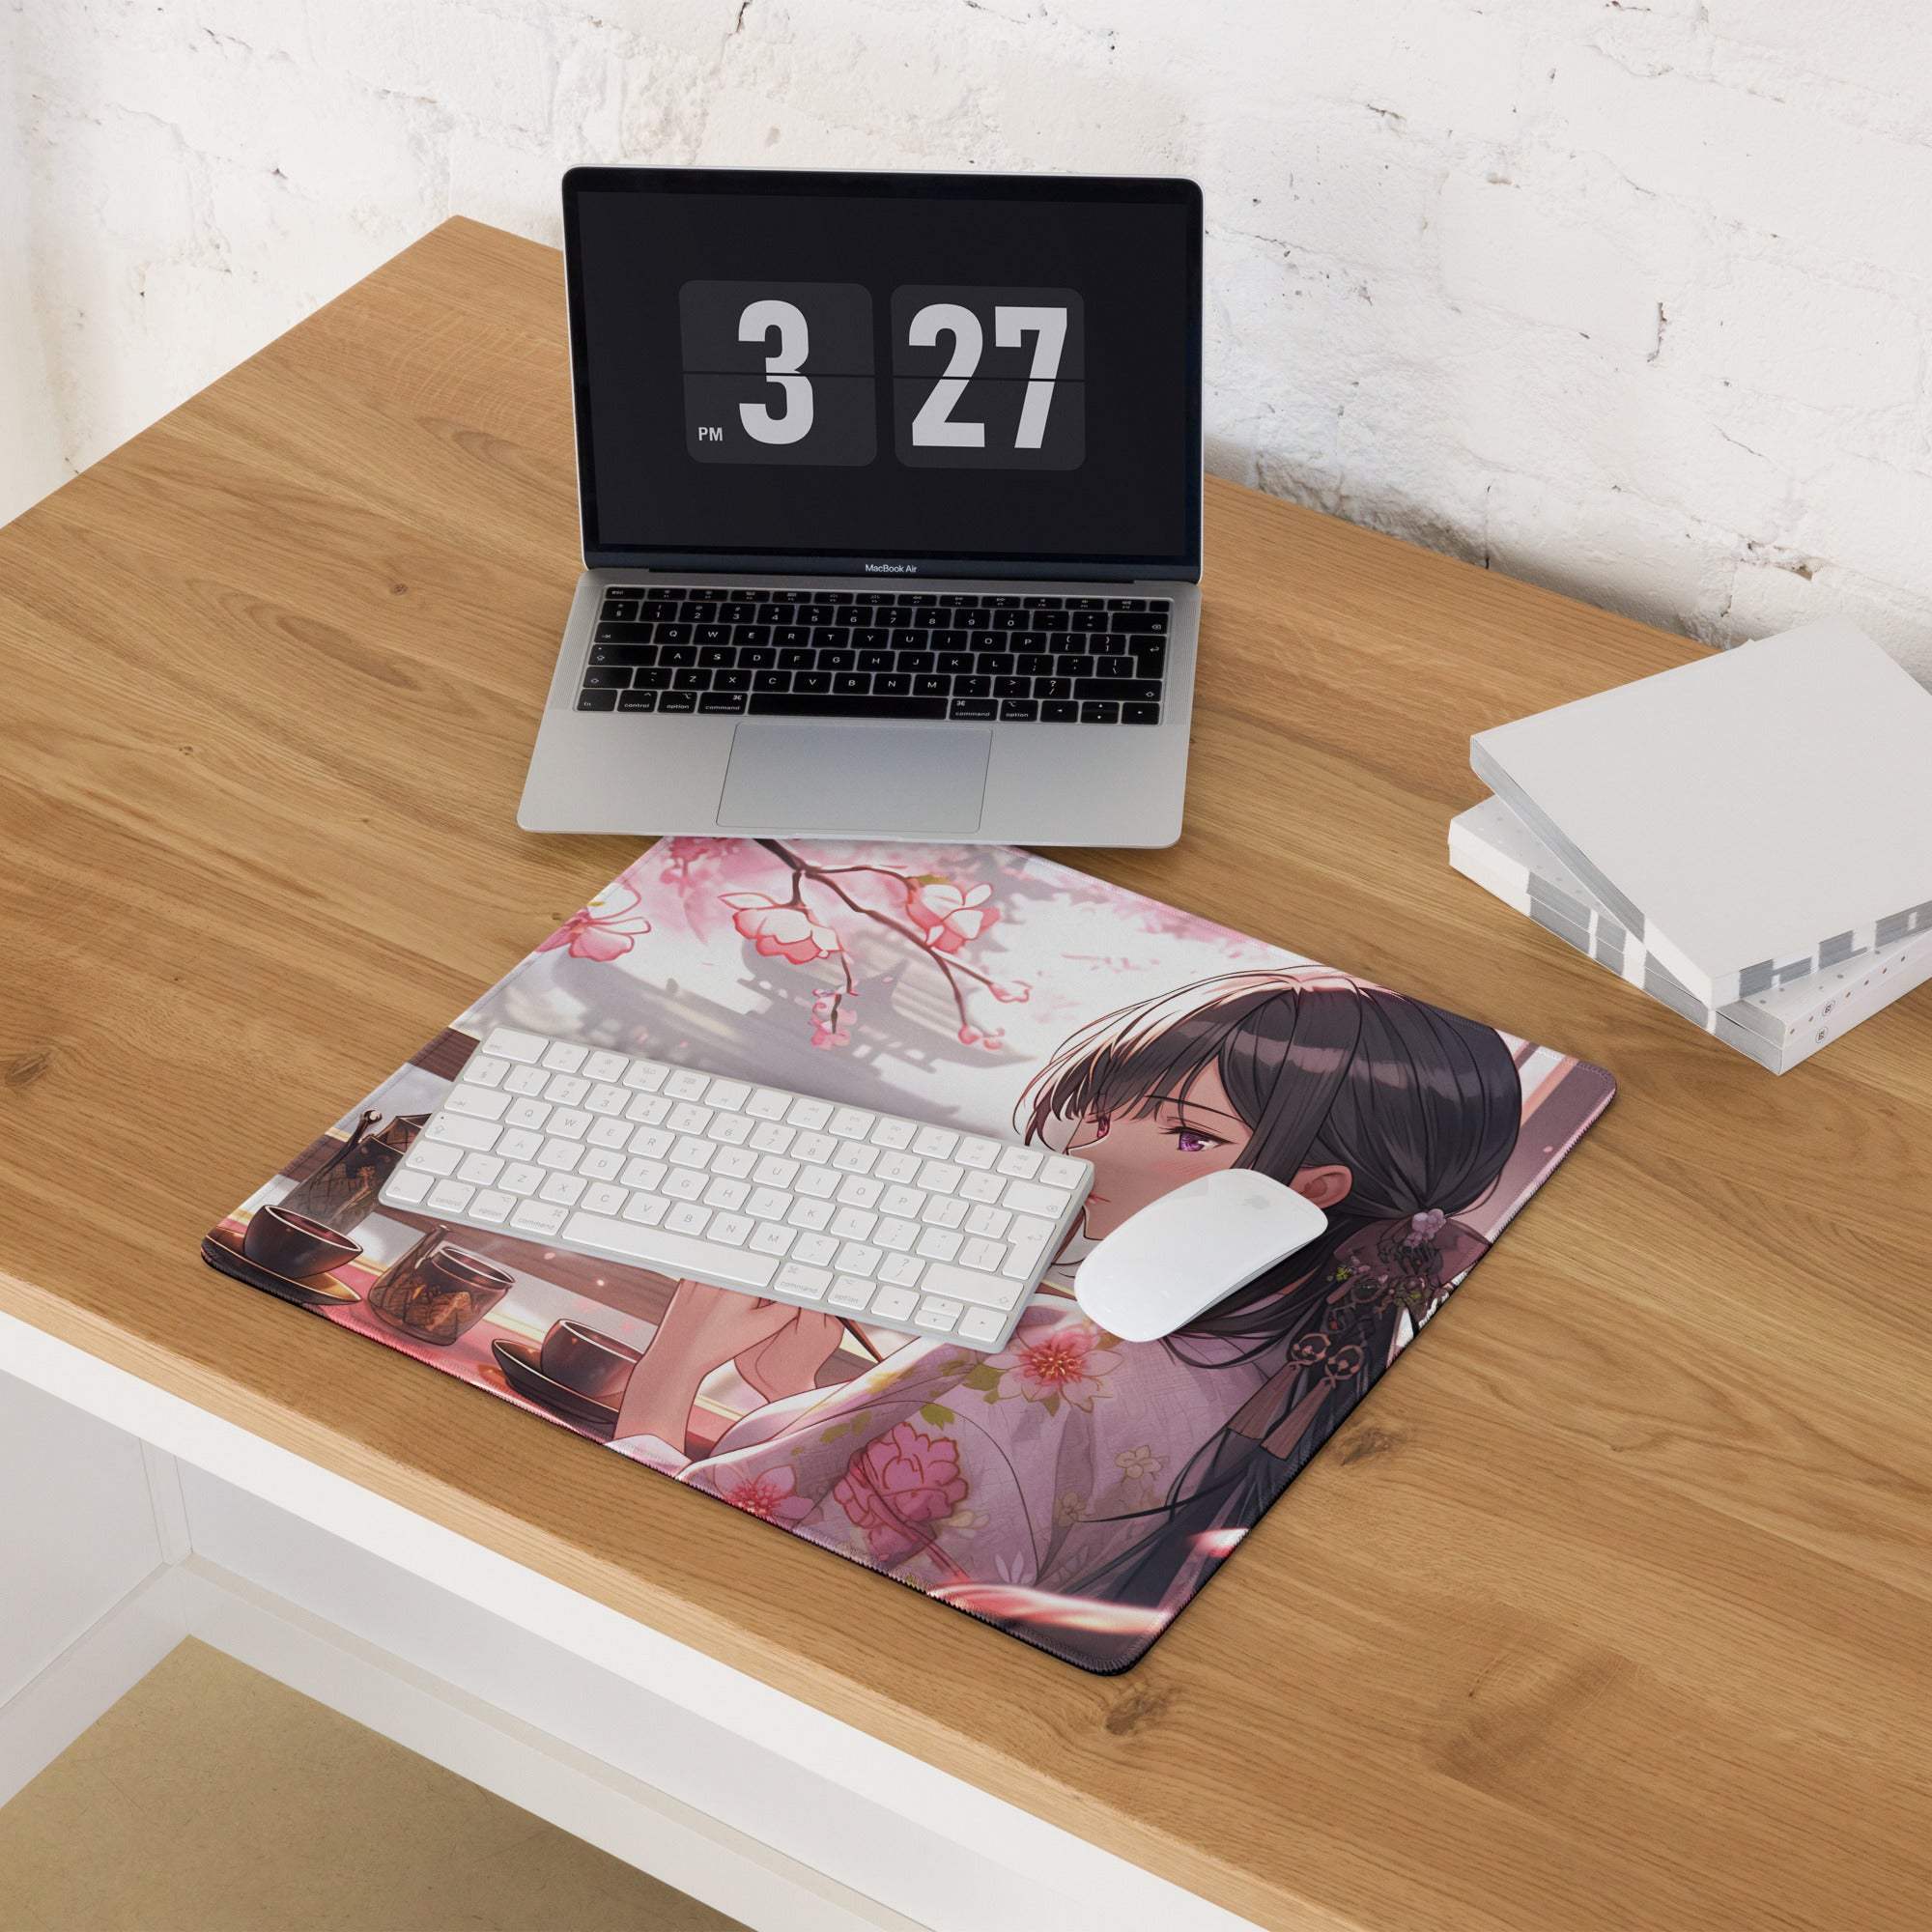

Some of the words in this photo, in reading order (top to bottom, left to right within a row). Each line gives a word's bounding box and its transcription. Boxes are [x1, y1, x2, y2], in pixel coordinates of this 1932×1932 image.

[738, 299, 814, 445] 3
[908, 303, 1067, 449] 27
[697, 426, 724, 441] PM
[865, 563, 904, 573] MacBook
[905, 564, 918, 573] Air
